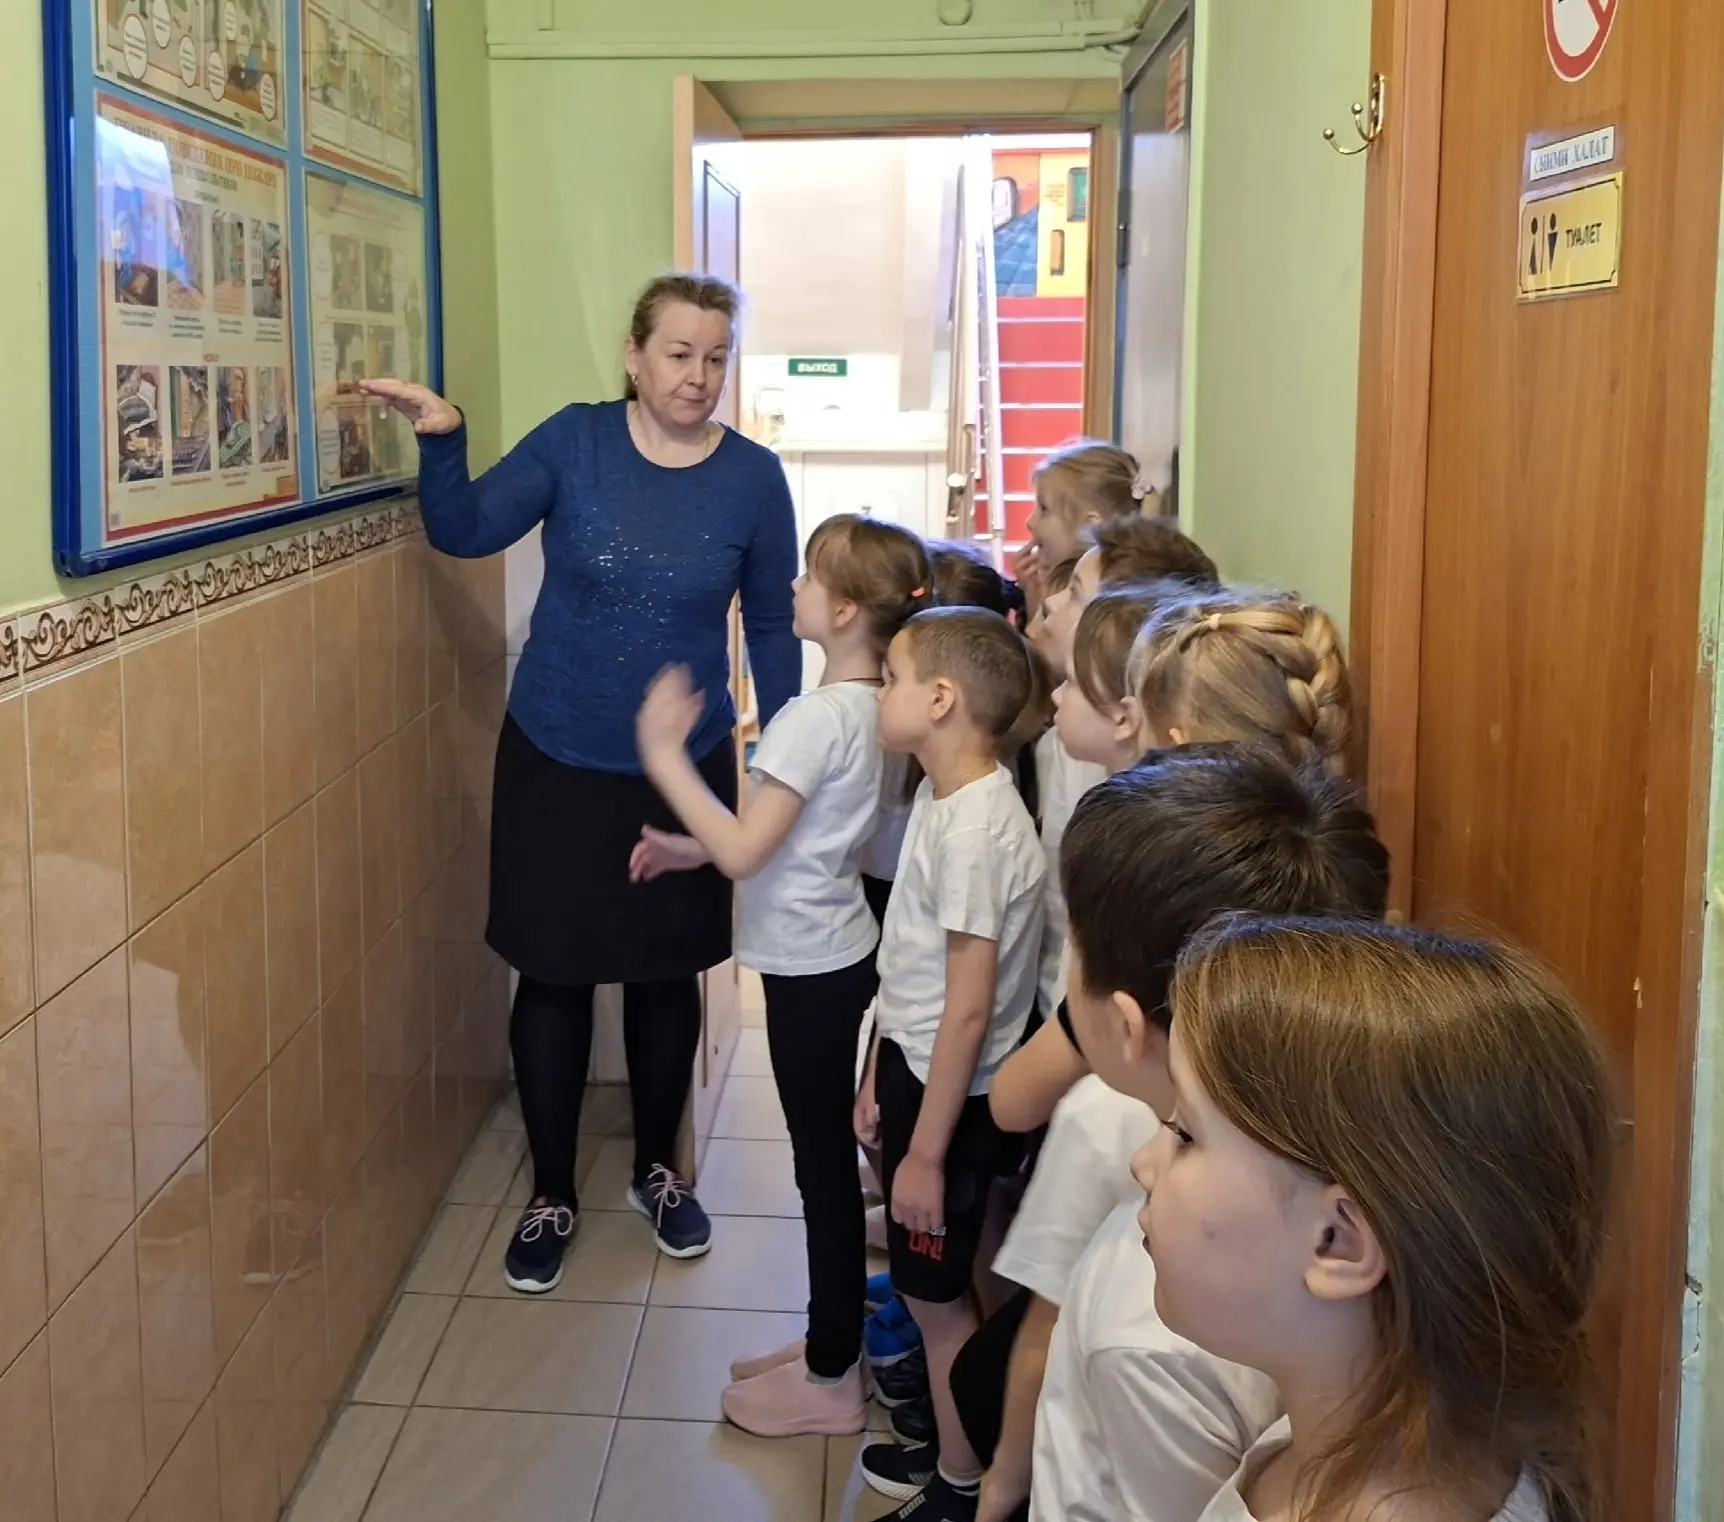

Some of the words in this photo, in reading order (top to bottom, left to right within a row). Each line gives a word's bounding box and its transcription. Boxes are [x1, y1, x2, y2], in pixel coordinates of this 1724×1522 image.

[1572, 136, 1609, 163] ХАЛАТ
[1565, 222, 1602, 249] ТУАЛЕТ
[797, 363, 838, 374] ВЫХОД
